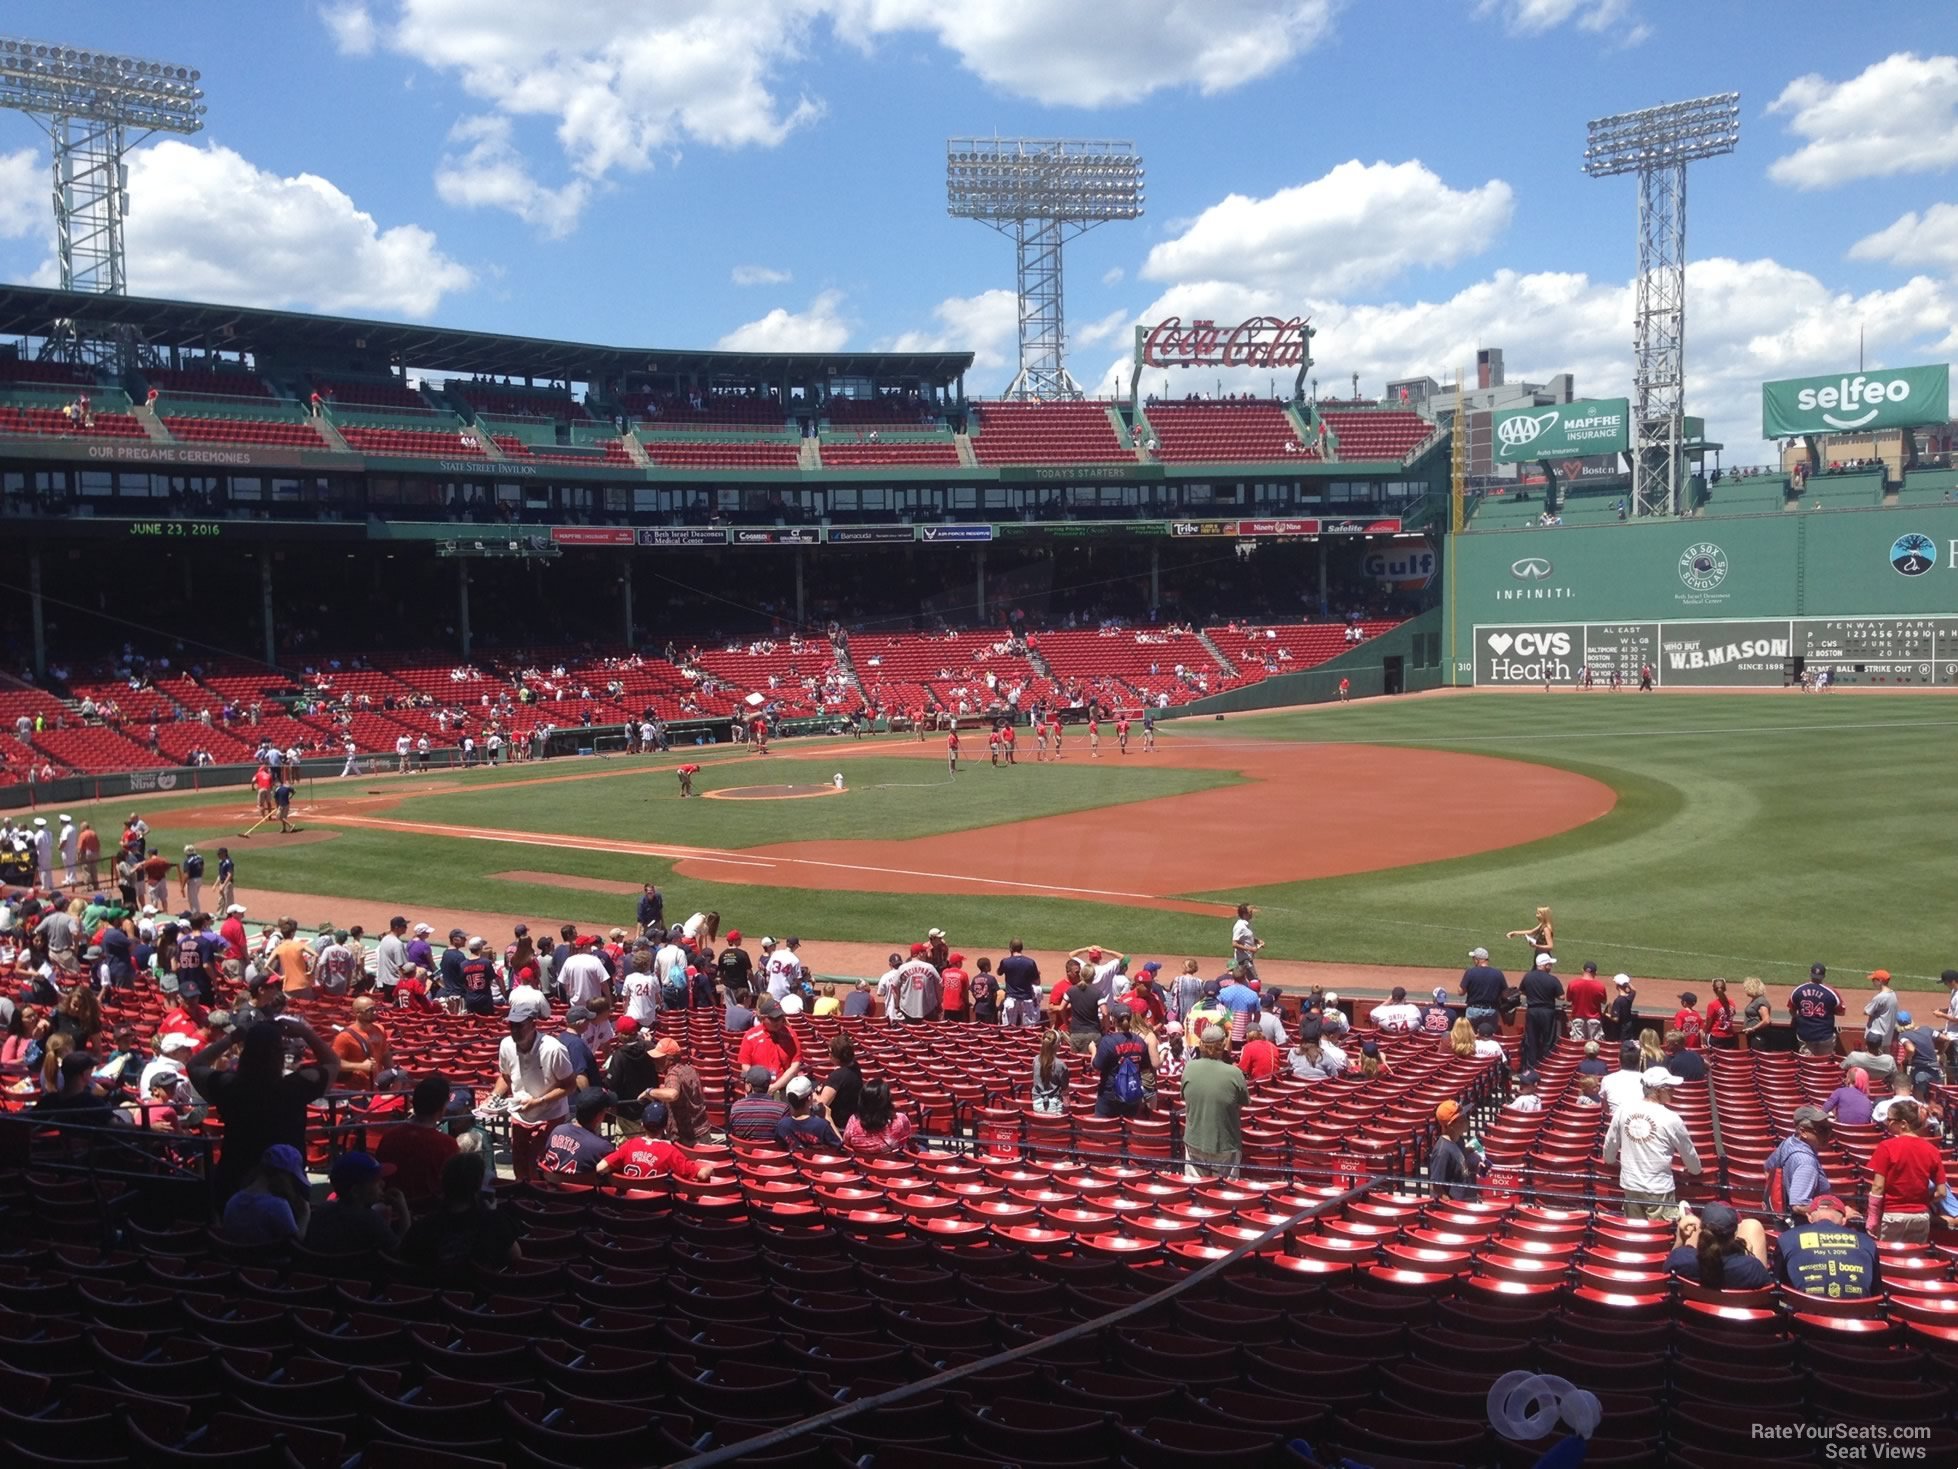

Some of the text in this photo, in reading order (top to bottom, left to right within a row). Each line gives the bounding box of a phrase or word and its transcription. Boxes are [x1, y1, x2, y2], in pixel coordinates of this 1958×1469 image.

[1144, 316, 1311, 368] Coca-Cola
[1503, 416, 1535, 443] AAA
[1564, 415, 1621, 430] MAPFRE
[1567, 429, 1617, 440] INSURANCE
[88, 447, 251, 463] OUR PREGAME CEREMONIES
[1552, 447, 1579, 455] Insurance
[440, 461, 537, 474] STATE STREET PAVILION
[1036, 468, 1126, 478] TODAY'S STARTERS
[130, 523, 220, 536] JUNE 23, 2016
[1173, 523, 1199, 535] Tribe
[1681, 544, 1719, 566] RED SOX
[1365, 554, 1432, 575] Gulf
[1682, 561, 1726, 588] SCHOLARS
[1514, 632, 1571, 656] CVS
[1663, 642, 1700, 651] WHO BUT
[1458, 663, 1471, 671] 310
[1490, 658, 1571, 680] Health
[130, 780, 156, 790] Nine
[771, 960, 792, 976] 34
[636, 983, 649, 996] 24
[1800, 1000, 1825, 1017] 34
[551, 1135, 581, 1155] ORTIZ
[631, 1150, 658, 1166] PRICE
